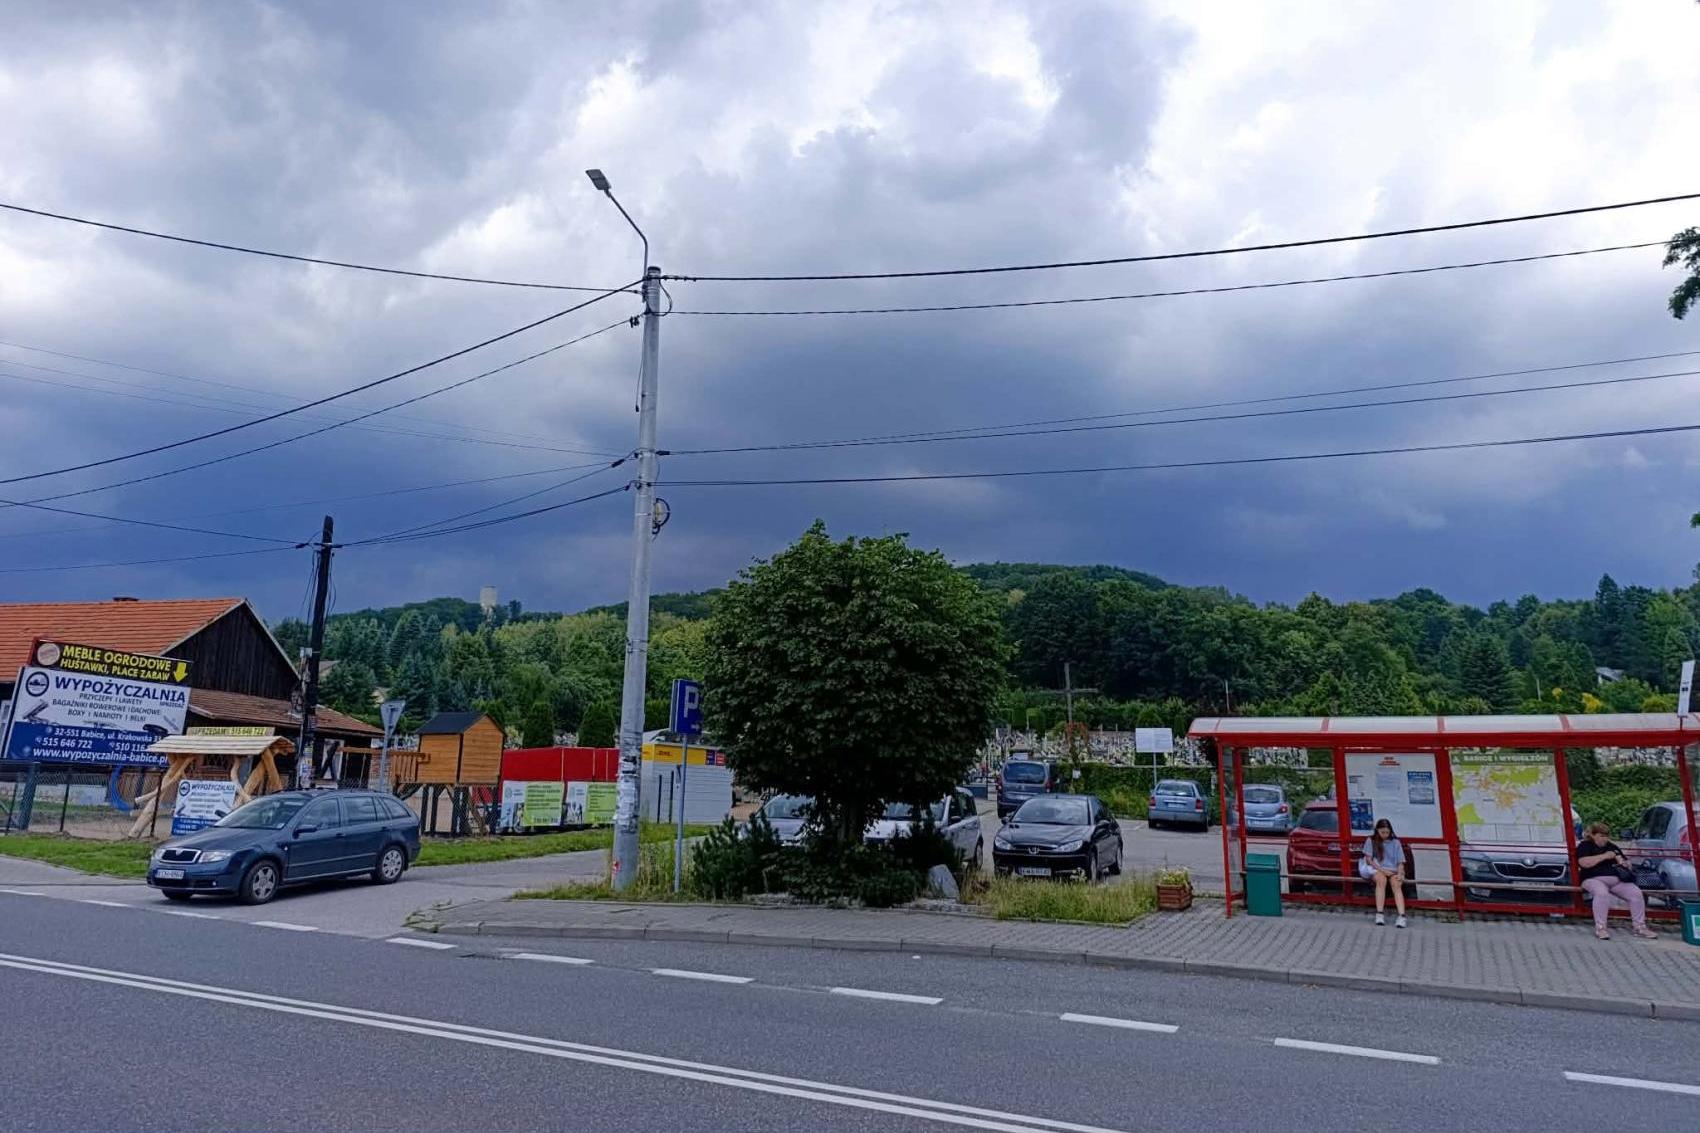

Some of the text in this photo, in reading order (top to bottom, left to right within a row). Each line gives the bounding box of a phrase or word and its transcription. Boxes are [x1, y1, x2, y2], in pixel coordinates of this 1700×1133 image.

[60, 657, 170, 680] HUŚTAWKI, PLACE ZABAW
[63, 645, 101, 661] MEBLE
[104, 651, 171, 671] OGRODOWE
[55, 676, 186, 703] WYPOŻYCZALNIA
[683, 685, 700, 718] P
[42, 737, 93, 749] 515 646 722
[54, 727, 79, 737] 32-551
[117, 732, 153, 742] Krakowska
[115, 742, 130, 751] 510
